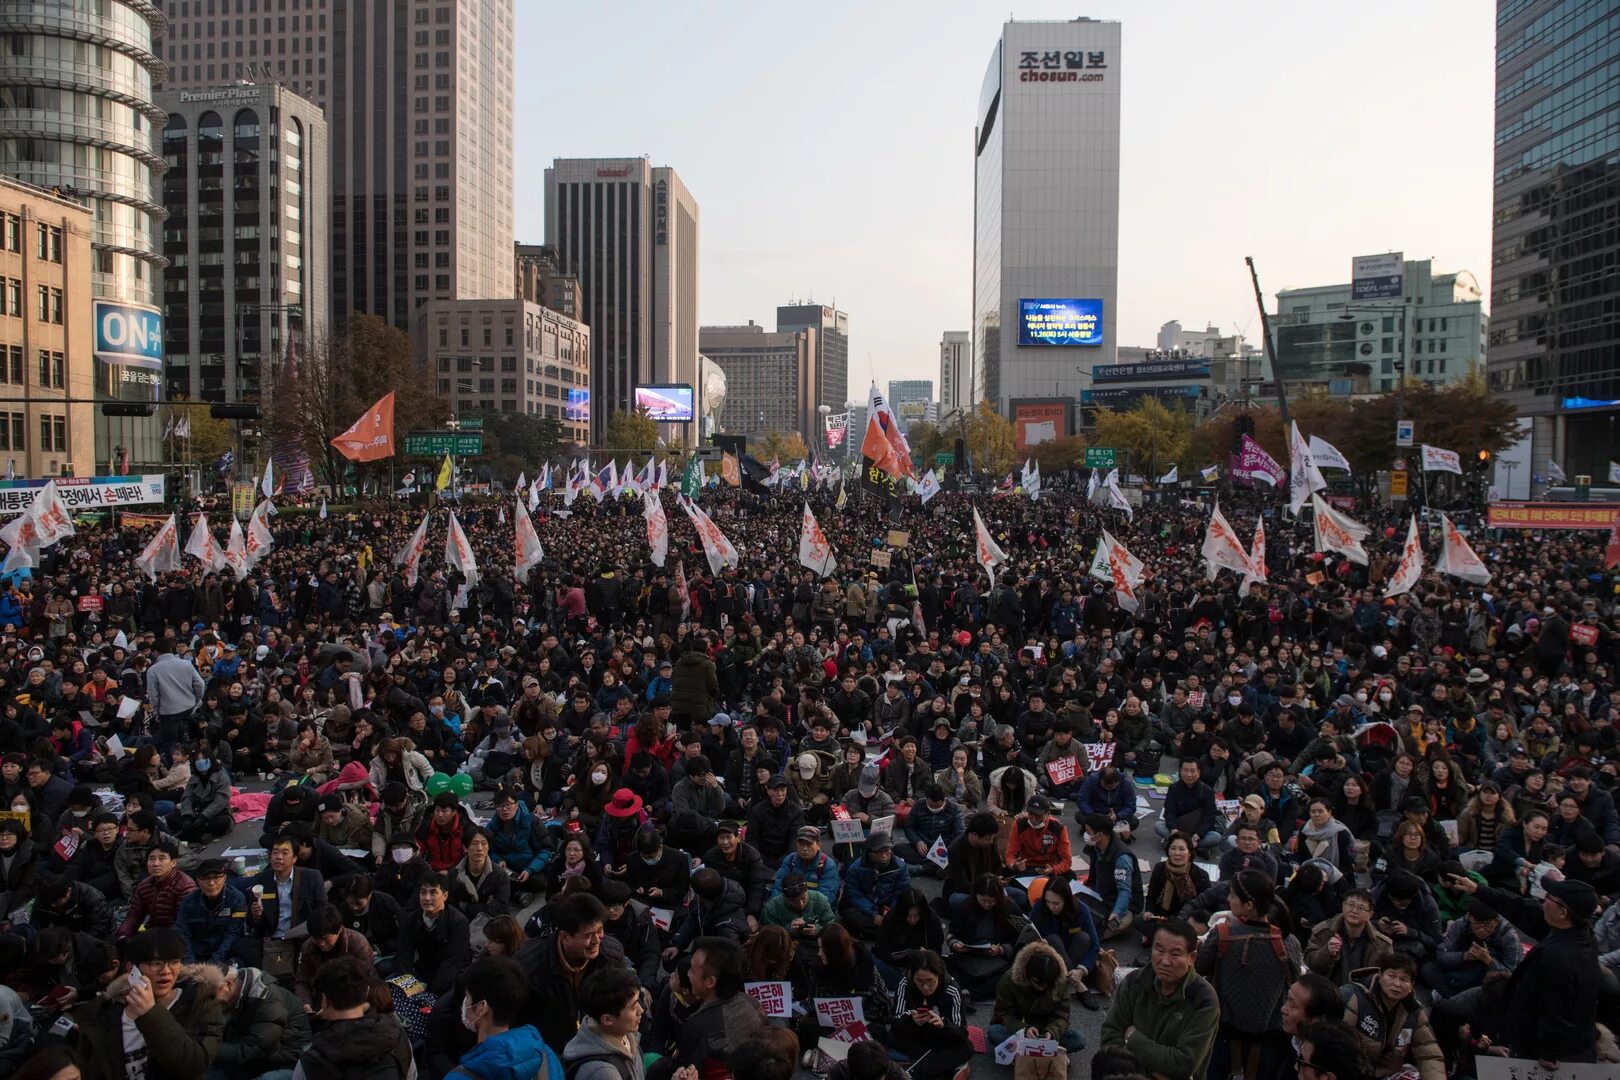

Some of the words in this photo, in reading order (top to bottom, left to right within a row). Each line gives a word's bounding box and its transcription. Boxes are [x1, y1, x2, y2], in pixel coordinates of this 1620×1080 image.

[1018, 51, 1107, 69] 조선일보
[1020, 70, 1104, 82] chosun.com
[180, 90, 227, 102] Premier
[227, 87, 259, 98] Place
[103, 312, 147, 350] ON
[1105, 367, 1133, 376] 신한은행
[1086, 743, 1105, 758] 근혜
[1049, 756, 1076, 773] 박근혜
[1057, 766, 1075, 782] 퇴진
[747, 983, 783, 1001] 박근혜
[761, 998, 784, 1014] 퇴진
[817, 1000, 854, 1015] 박근혜
[833, 1012, 856, 1026] 퇴진
